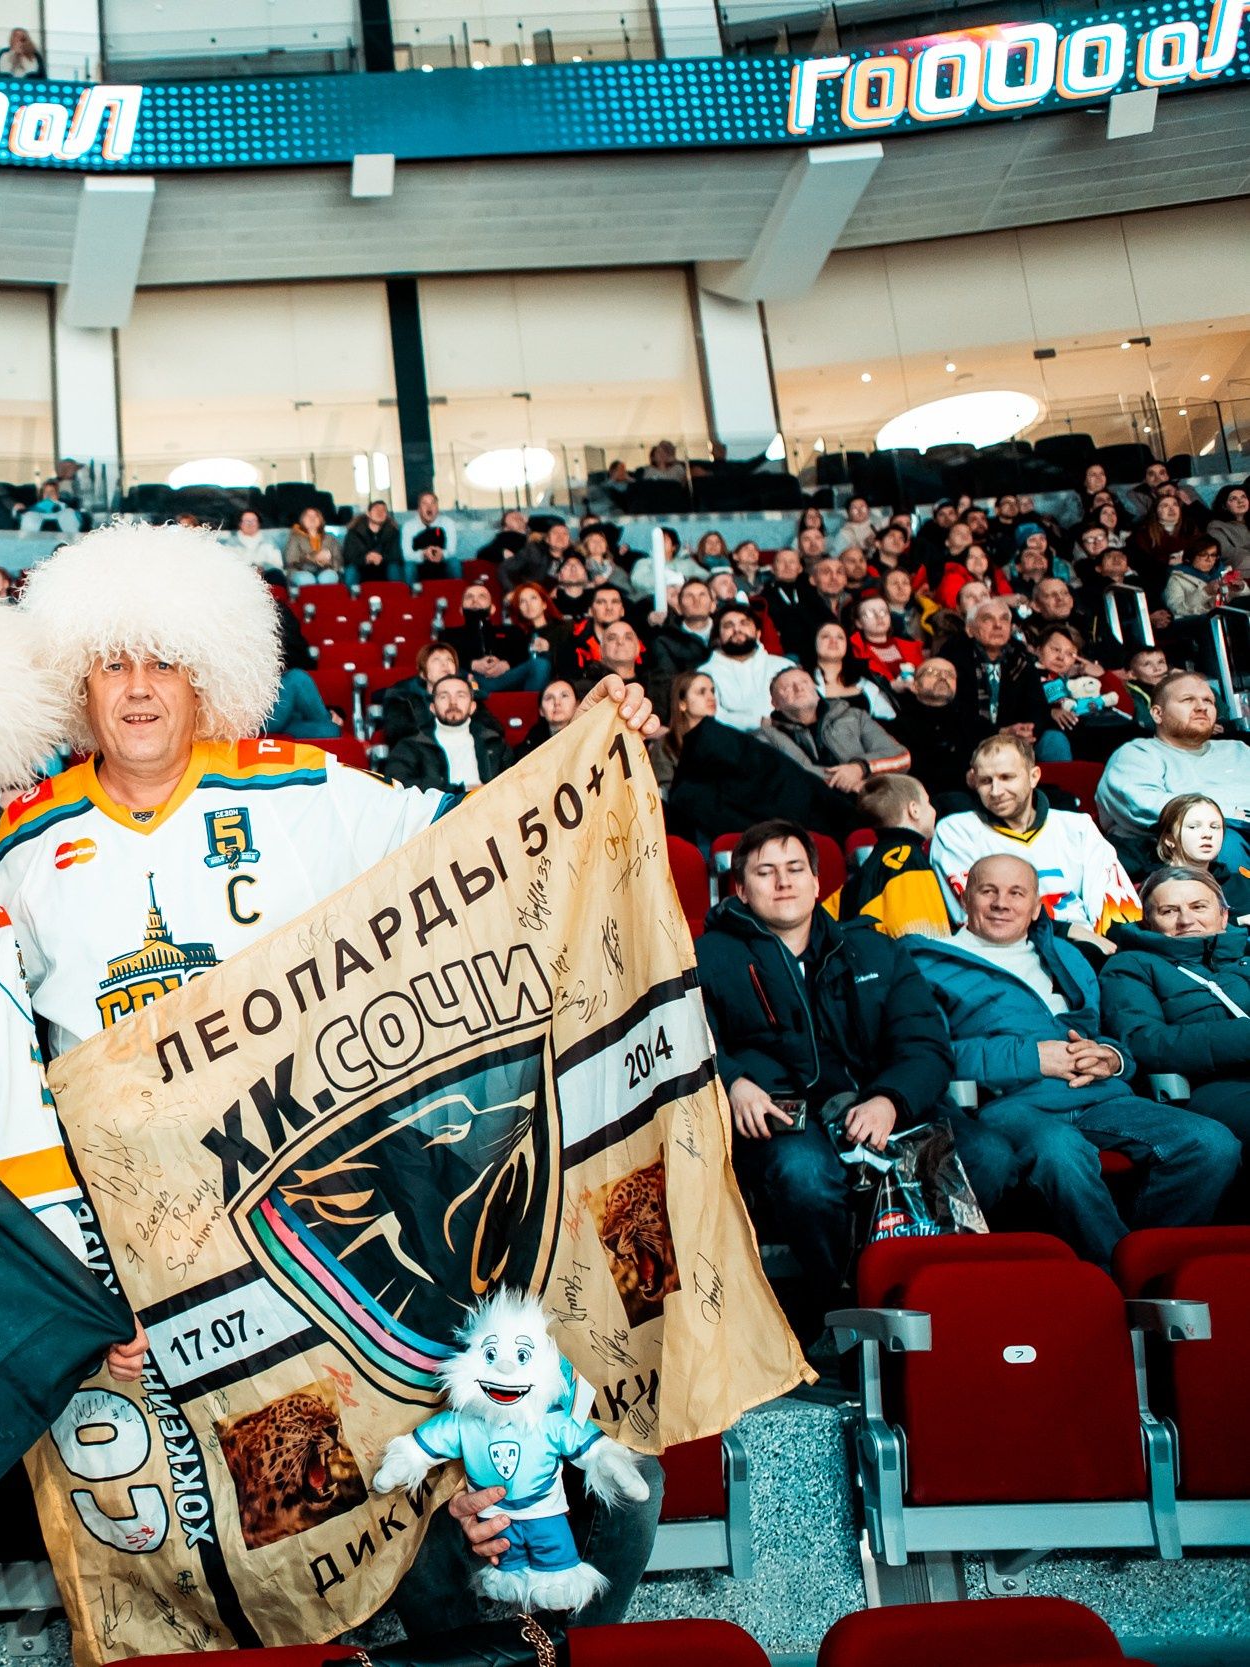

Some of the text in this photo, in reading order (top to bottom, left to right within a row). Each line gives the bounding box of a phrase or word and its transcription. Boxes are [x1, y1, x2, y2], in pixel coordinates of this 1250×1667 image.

[213, 815, 246, 856] 5
[214, 808, 239, 819] СЕЗОН
[155, 835, 509, 1084] ЛЕОПАРДЫ
[517, 732, 633, 858] 50+1
[170, 1309, 265, 1366] 17.07.
[1014, 1350, 1024, 1359] 7
[140, 1350, 215, 1551] ХОККЕЙН
[308, 1463, 447, 1599] ДИКИ
